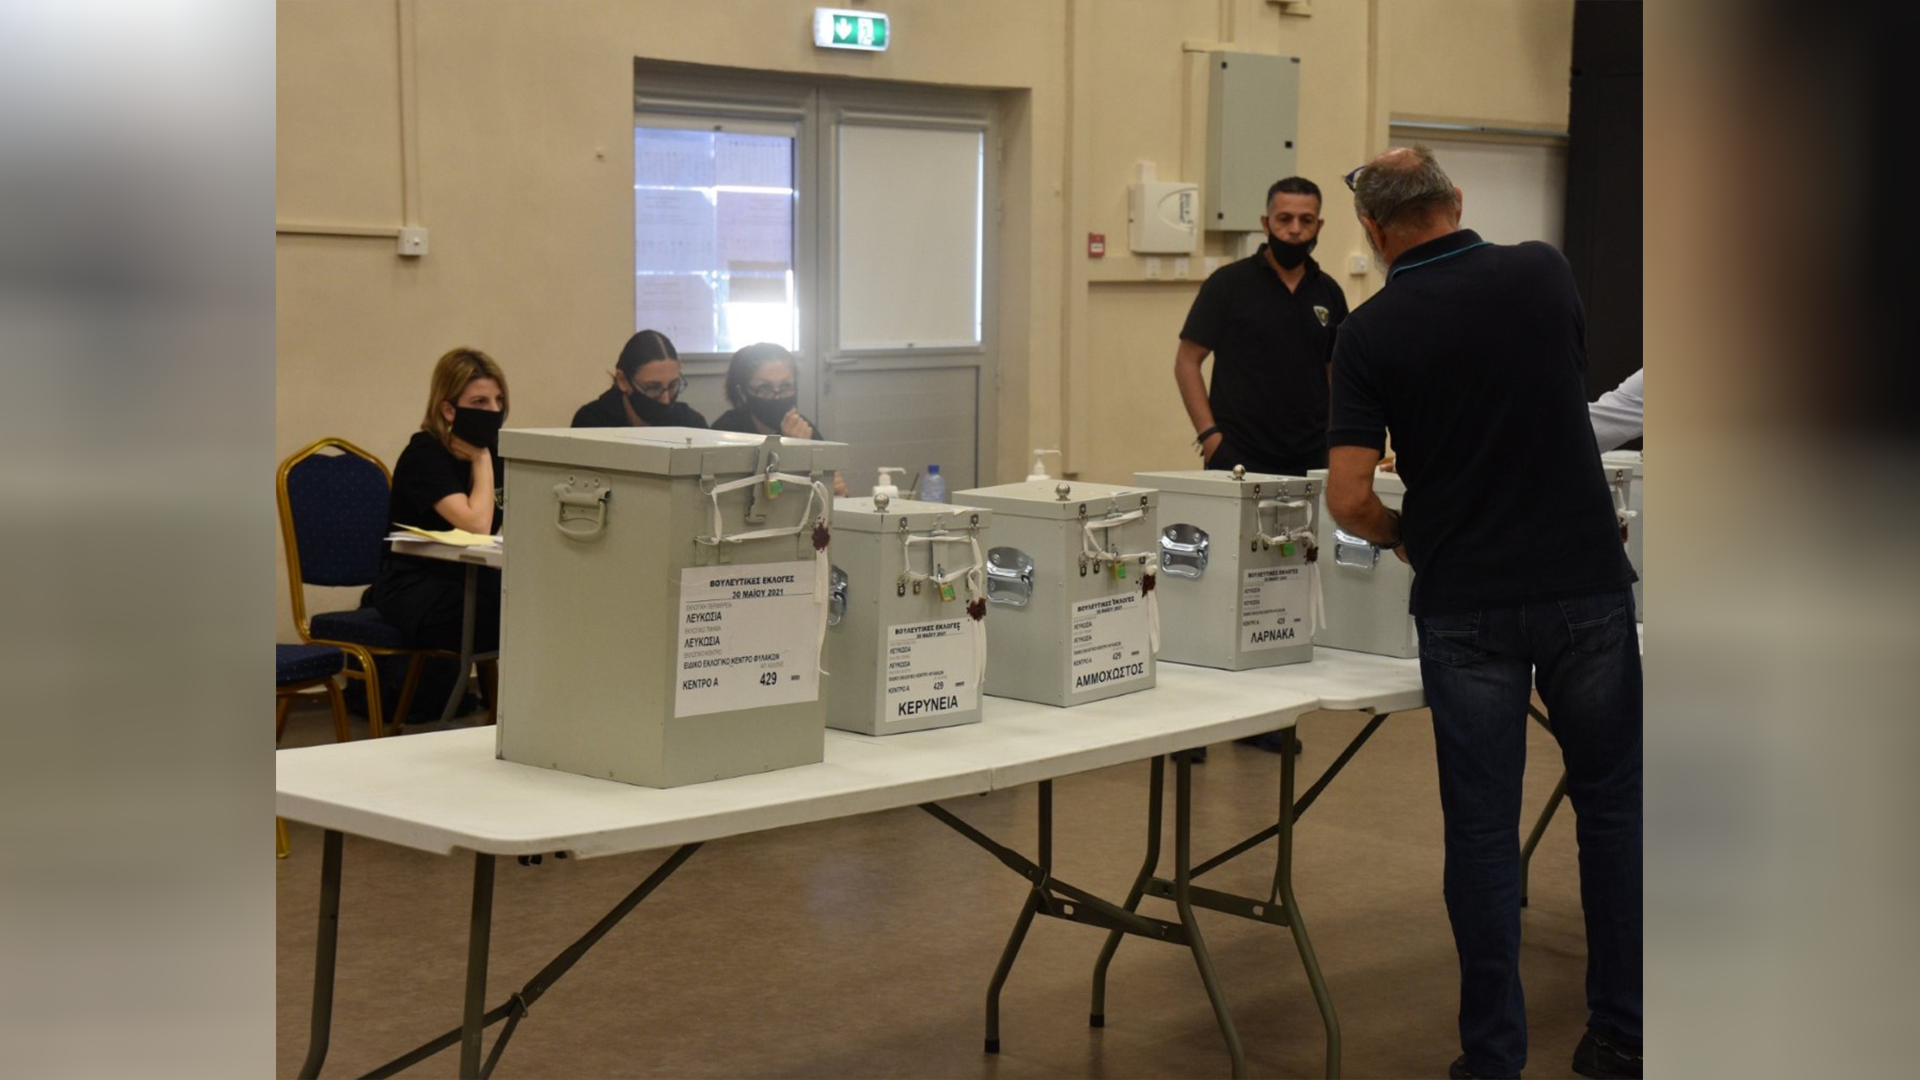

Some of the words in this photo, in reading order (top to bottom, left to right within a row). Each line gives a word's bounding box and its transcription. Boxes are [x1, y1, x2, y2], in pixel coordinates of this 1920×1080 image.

[709, 577, 760, 588] ΒΟΥΛΕΥΤΙΚΕΣ
[762, 575, 795, 584] ΕΚΛΟΓΕΣ
[732, 590, 741, 599] 30
[767, 588, 784, 597] 2021
[686, 611, 722, 623] ΛΕΥΚΩΣΙΑ
[684, 636, 720, 648] ΛΕΥΚΩΣΙΑ
[1250, 627, 1295, 643] ΛΑΡΝΑΚΑ
[683, 660, 702, 670] ΕΙΔΙΚΟ
[703, 658, 731, 668] ΕΚΛΟΓΙΚΟ
[731, 655, 753, 665] ΚΕΝΤΡΟ
[682, 678, 712, 690] ΚΕΝΤΡΟ
[713, 678, 719, 686] Α
[759, 672, 777, 686] 429
[1075, 662, 1143, 688] ΑΜΜΟΧΩΣΤΟΣ
[933, 681, 944, 690] 429
[898, 695, 958, 716] ΚΕΡΥΝΕΙΑ
